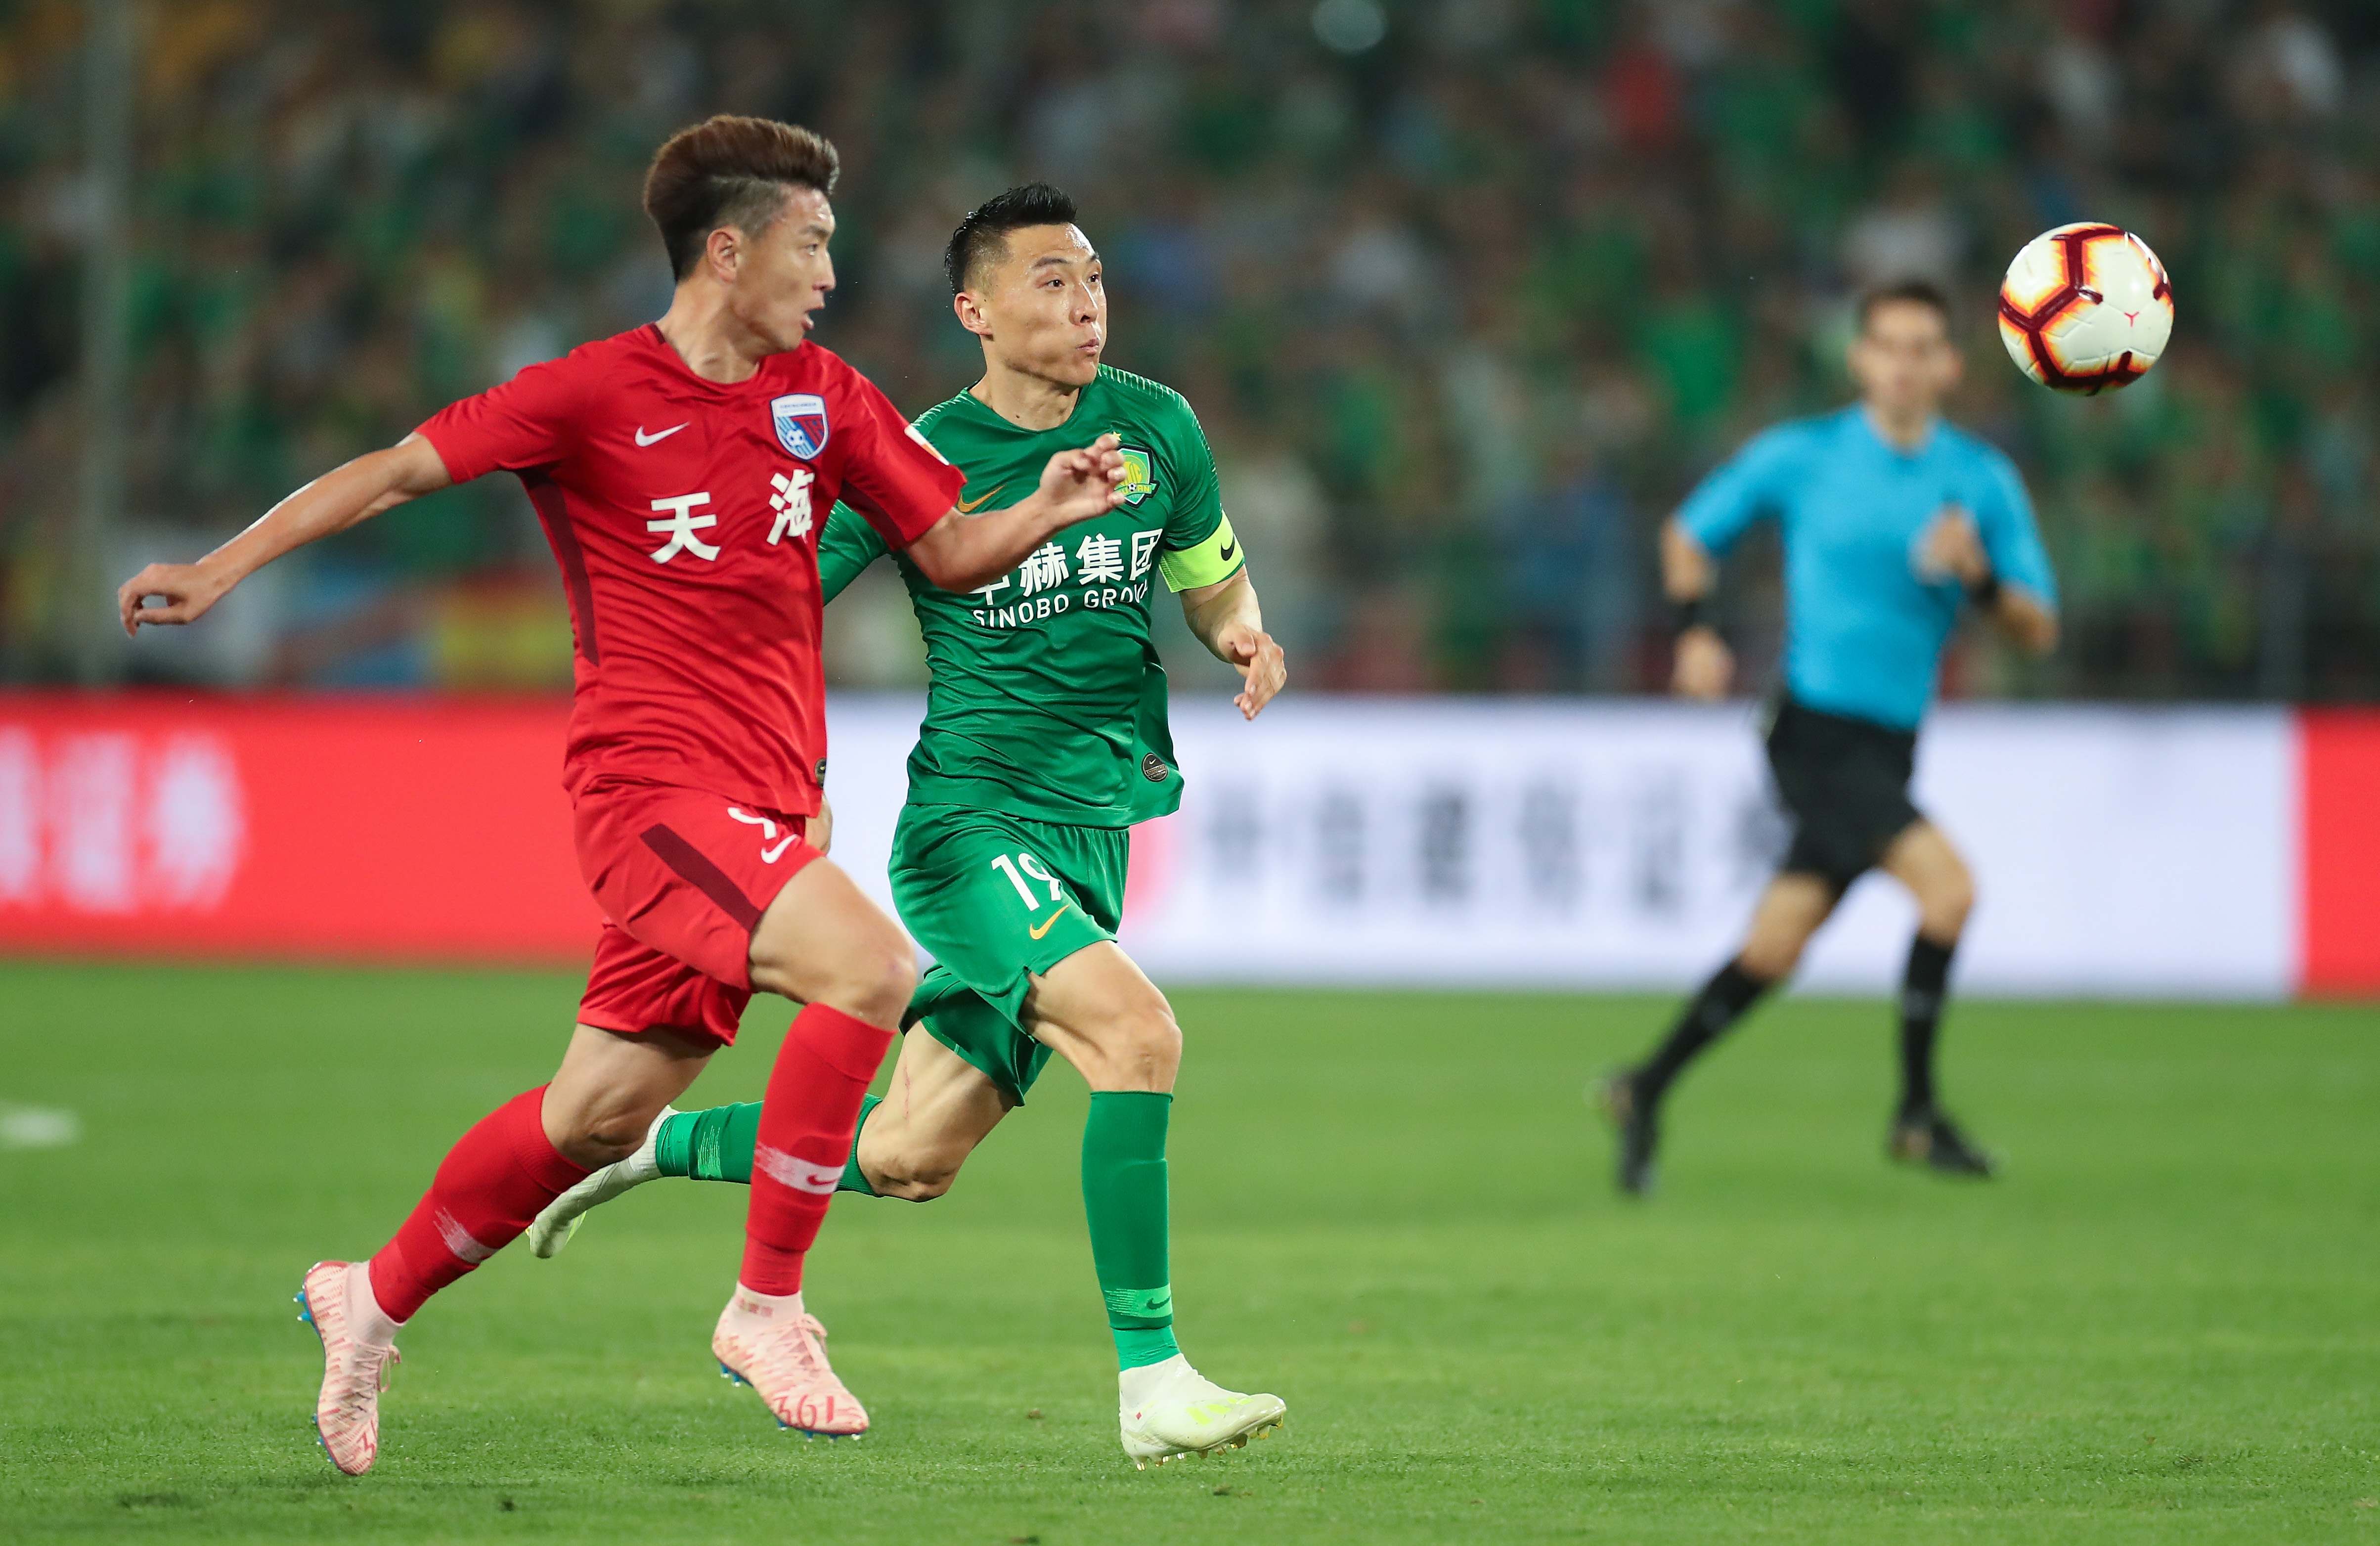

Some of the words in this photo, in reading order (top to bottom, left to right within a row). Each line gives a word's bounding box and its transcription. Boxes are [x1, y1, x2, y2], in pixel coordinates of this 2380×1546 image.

[647, 469, 815, 564] 天海
[973, 595, 1069, 628] SINOBO
[991, 853, 1062, 911] 19
